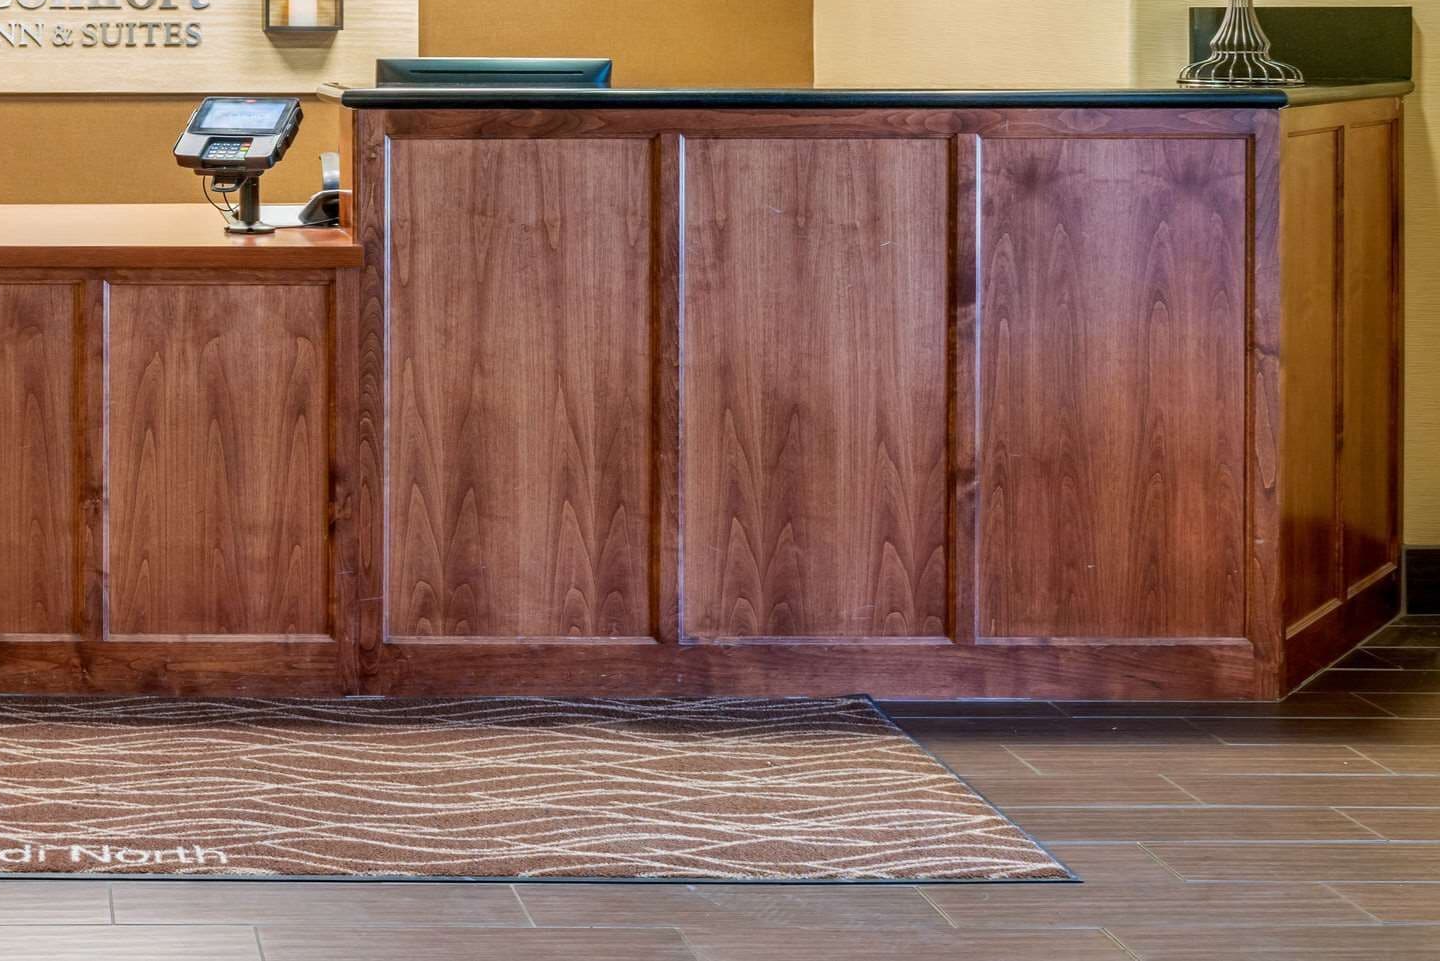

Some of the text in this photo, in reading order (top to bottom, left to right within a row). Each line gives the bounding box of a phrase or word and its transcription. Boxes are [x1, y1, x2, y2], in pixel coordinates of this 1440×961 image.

[52, 23, 73, 48] &
[81, 21, 203, 48] SUITES
[70, 845, 229, 865] North
